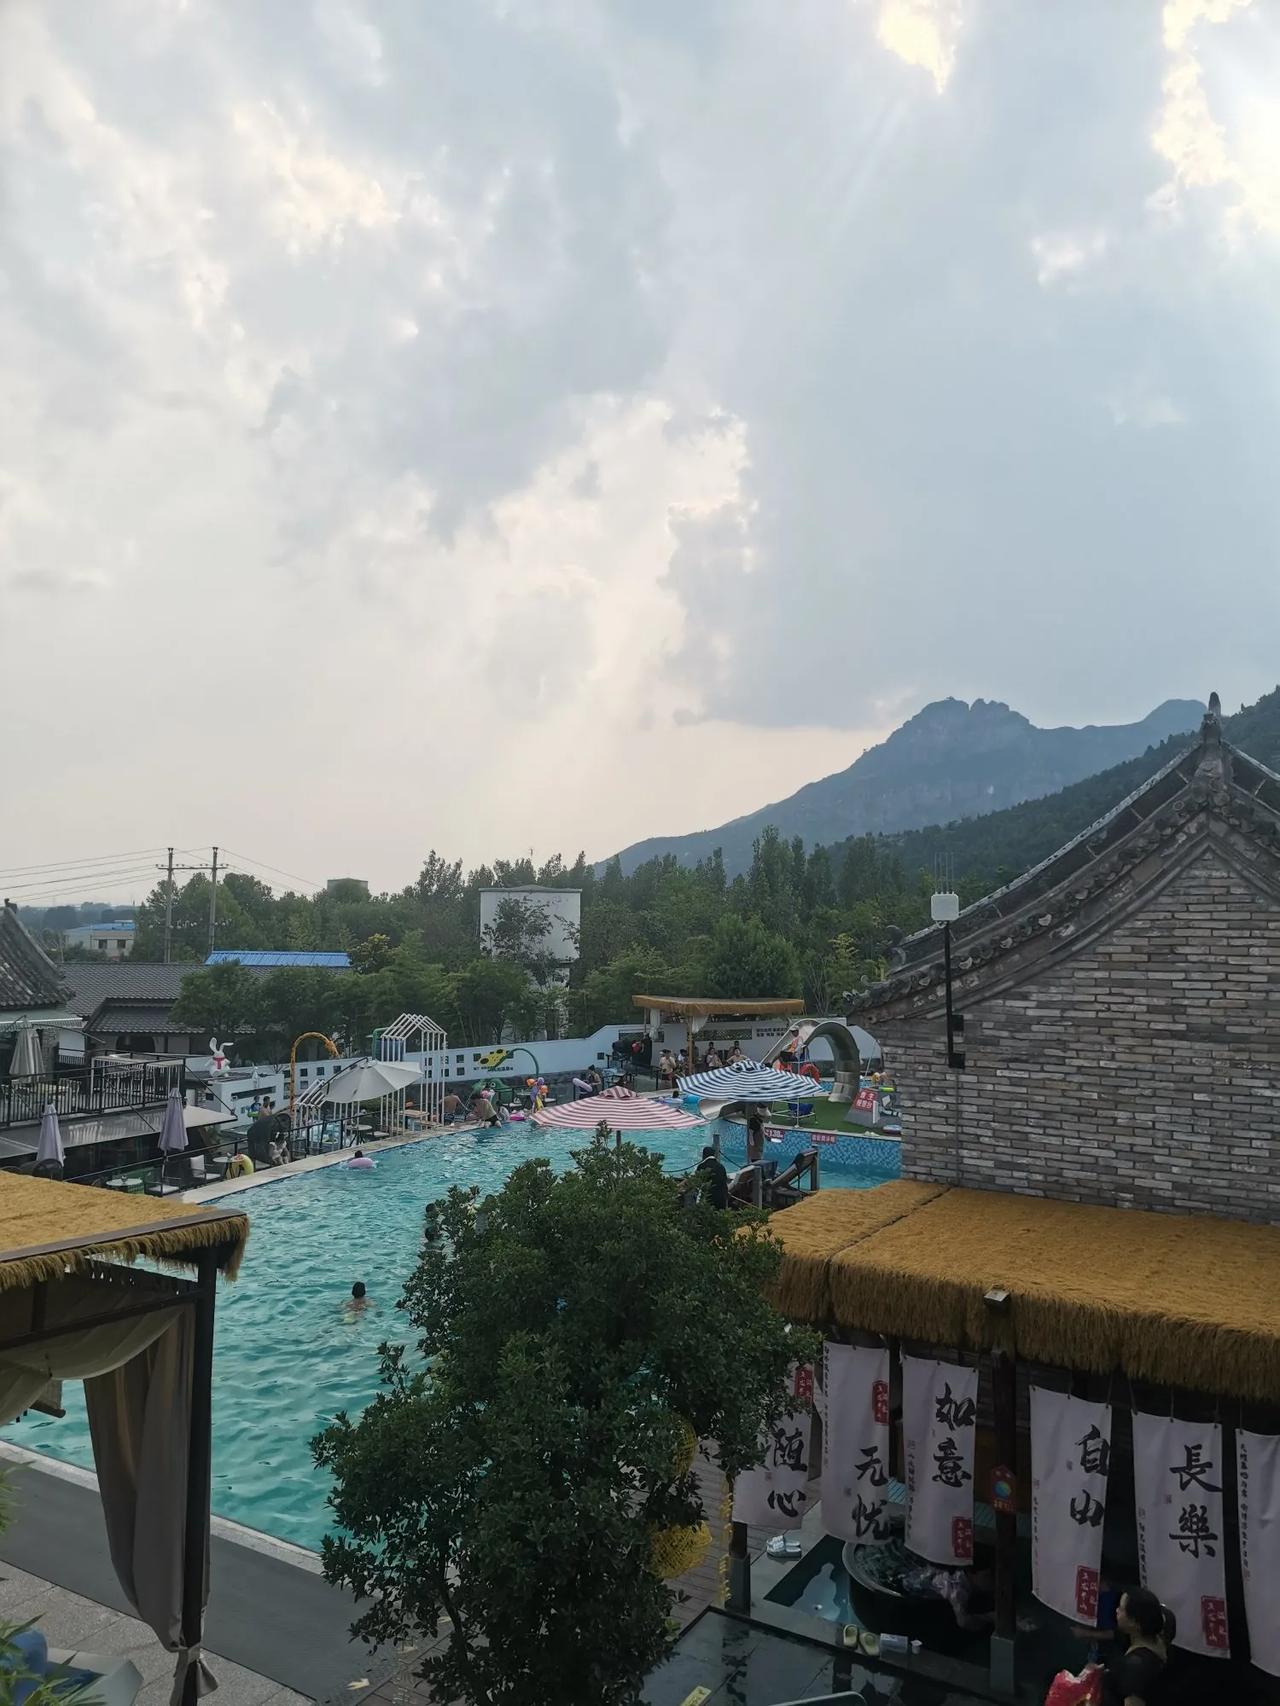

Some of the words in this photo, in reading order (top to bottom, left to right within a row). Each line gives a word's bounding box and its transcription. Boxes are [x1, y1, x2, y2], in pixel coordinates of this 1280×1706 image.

[767, 1428, 807, 1517] 随心
[932, 1382, 975, 1488] 如意
[1069, 1423, 1110, 1527] 自由
[851, 1446, 893, 1540] 无忧
